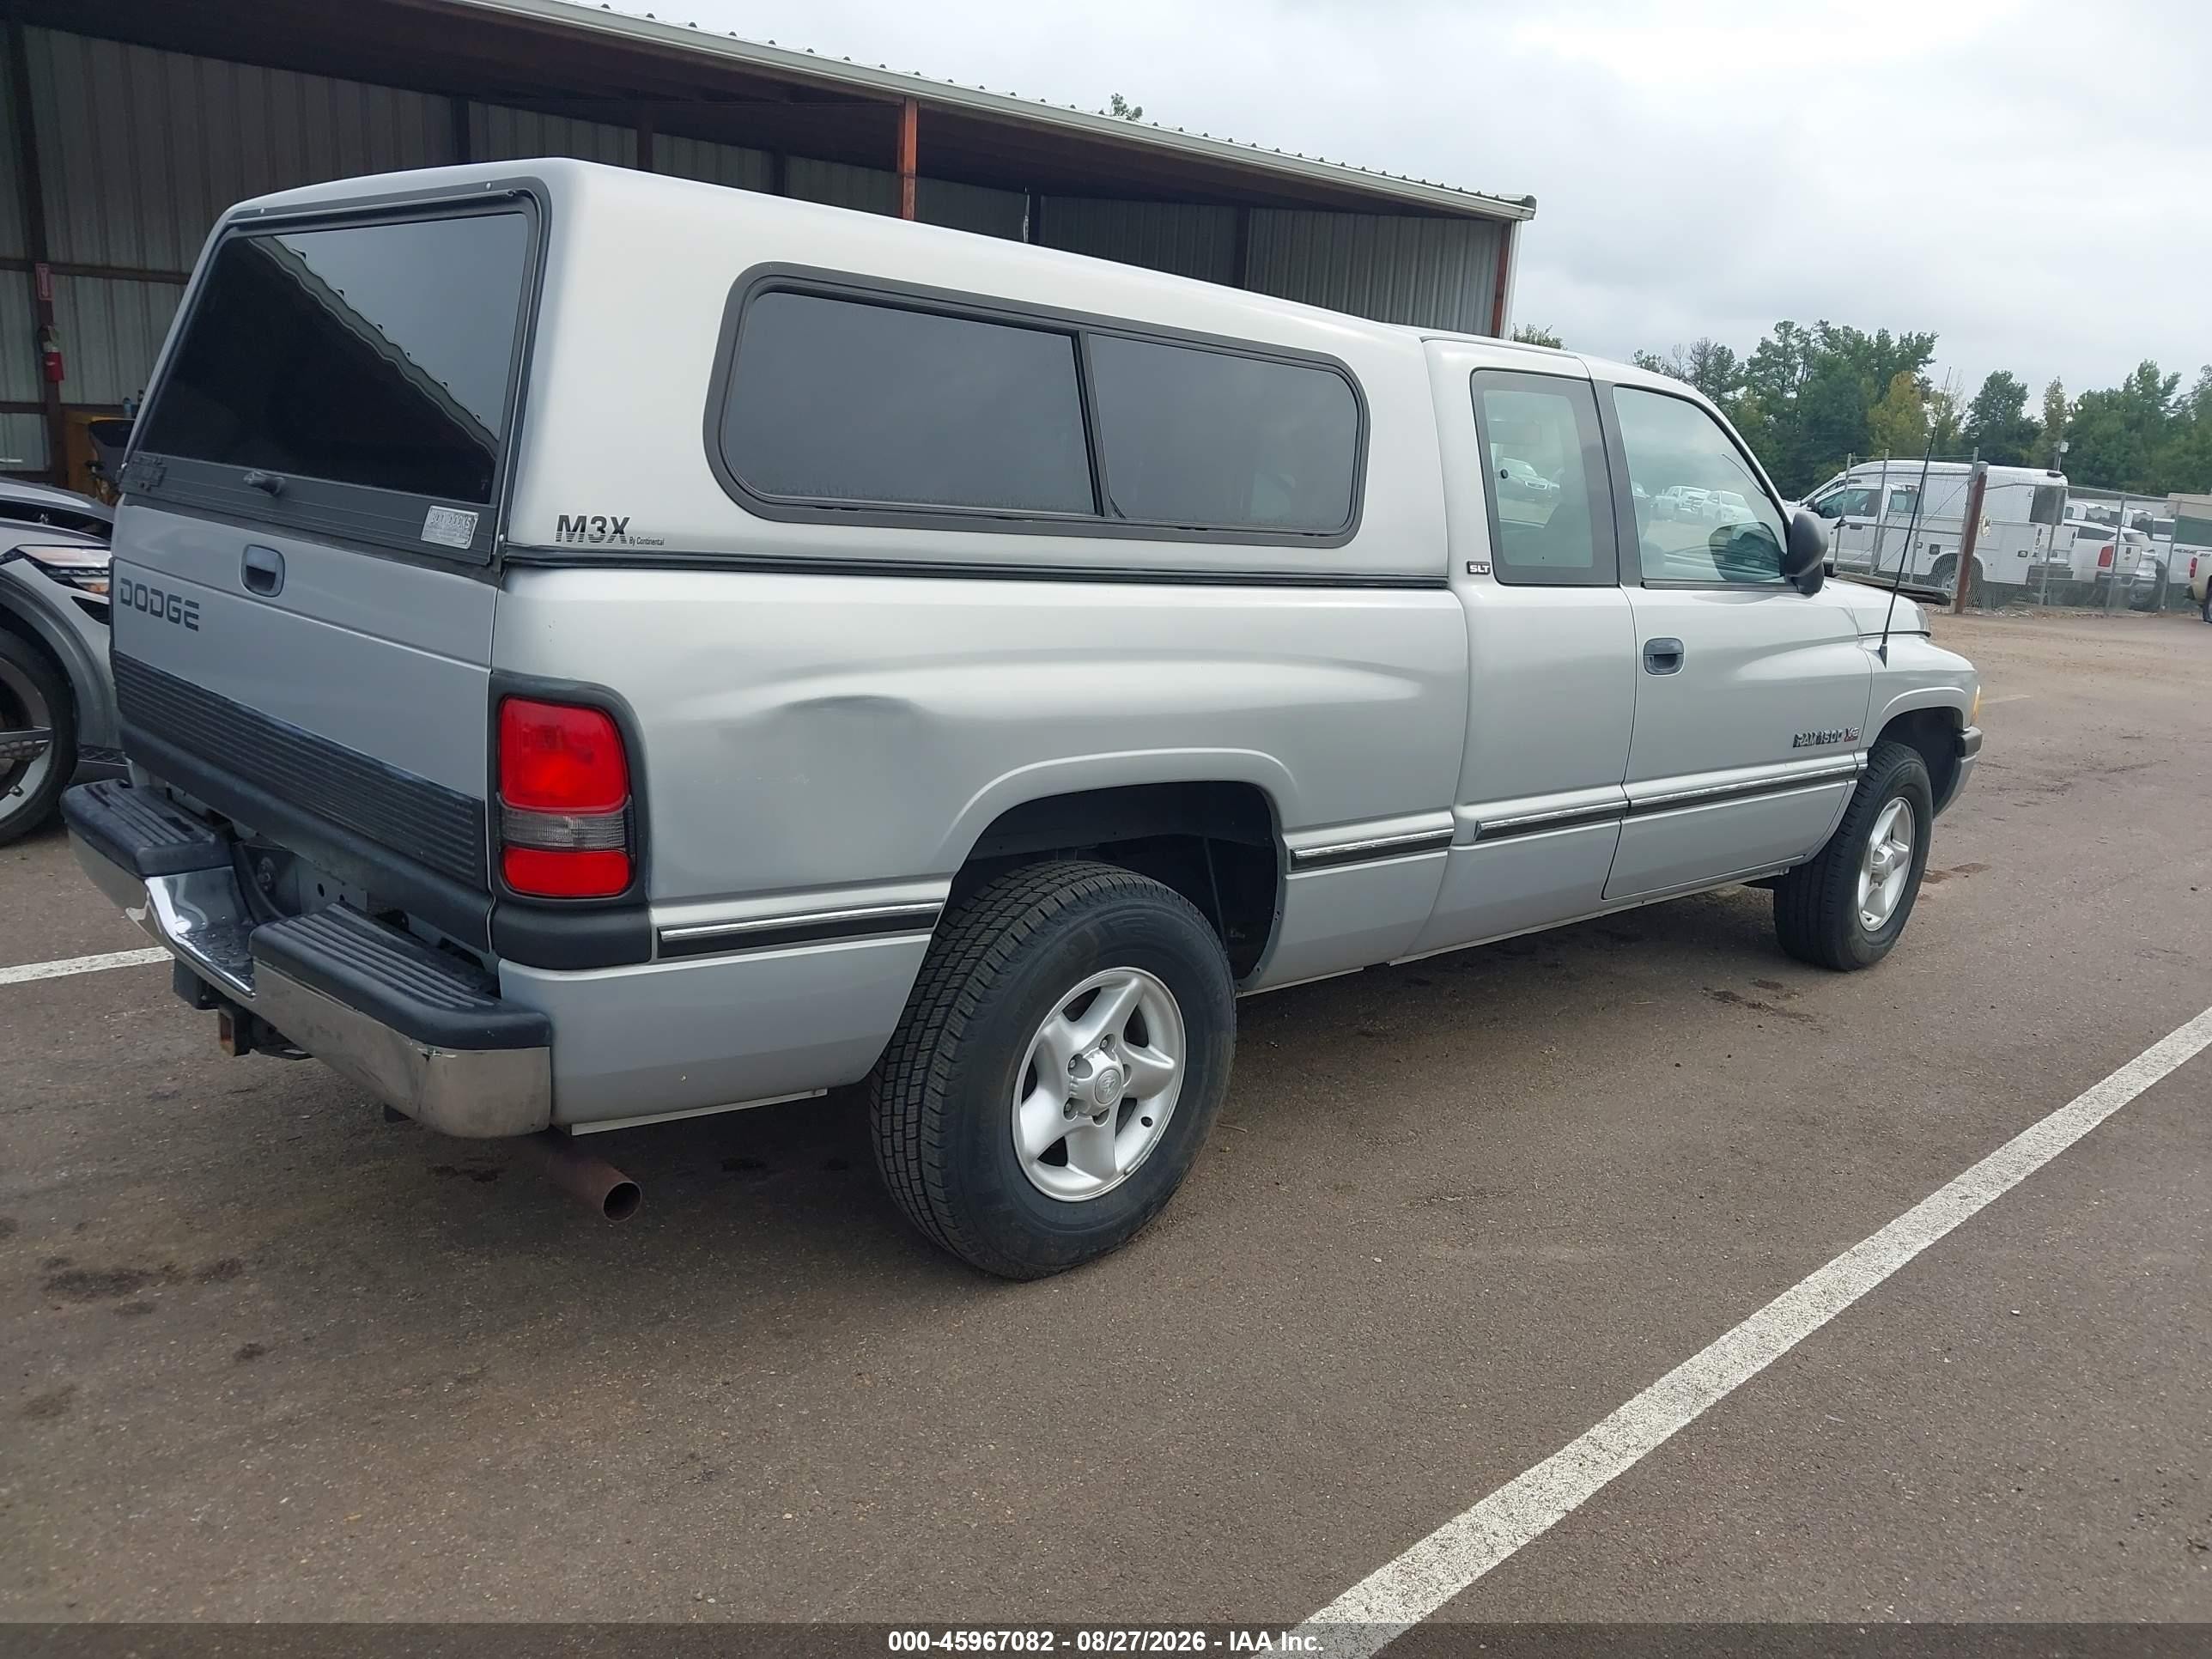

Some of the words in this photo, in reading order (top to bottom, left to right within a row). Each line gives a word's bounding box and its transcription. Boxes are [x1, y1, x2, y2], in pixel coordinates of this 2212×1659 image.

[556, 515, 630, 544] M3X
[629, 536, 636, 546] By
[636, 537, 665, 546] Continental
[1469, 564, 1490, 574] SLT
[120, 578, 199, 632] DODGE
[1793, 730, 1818, 747] RAM
